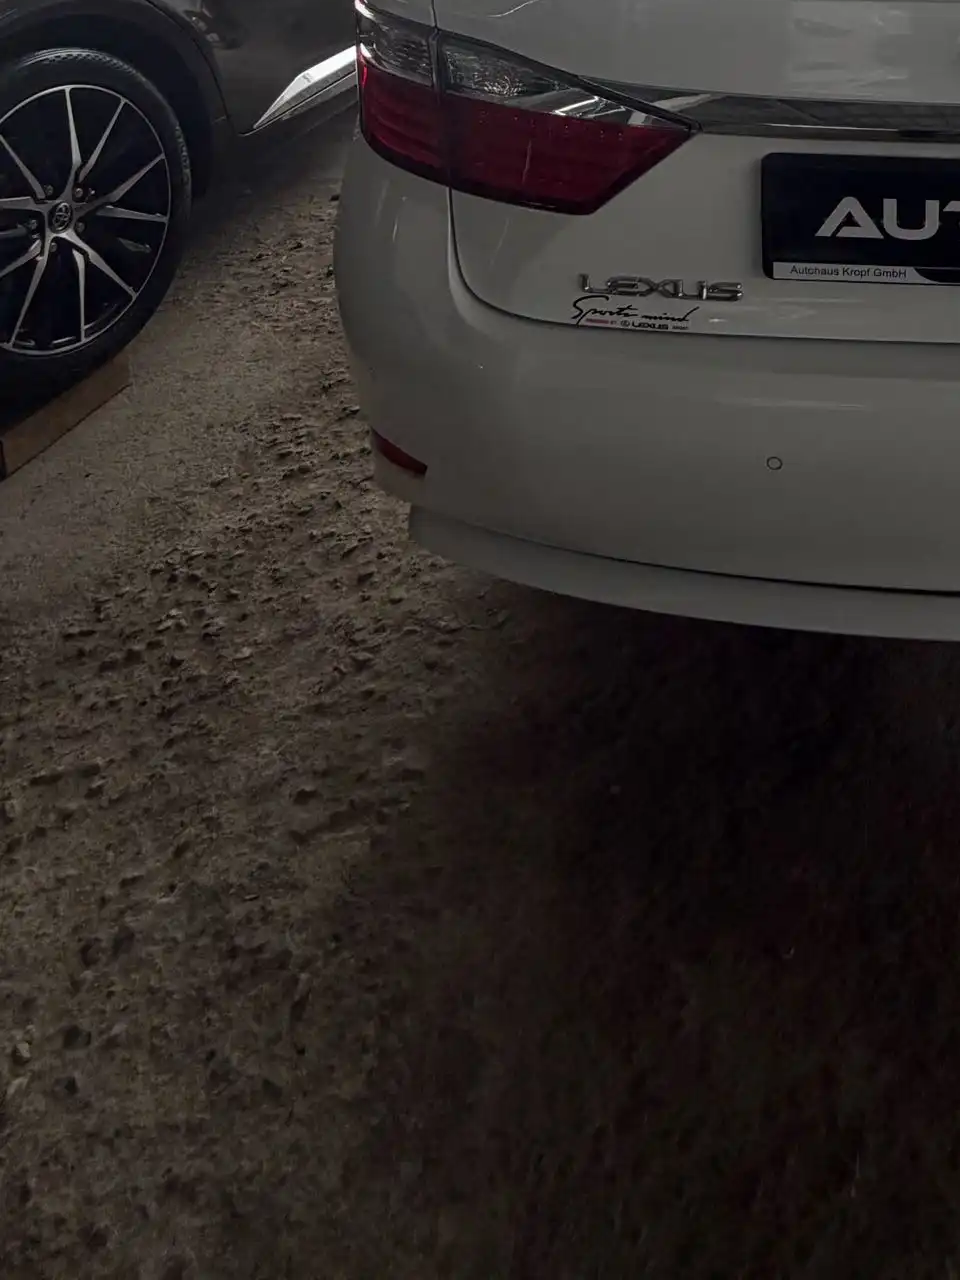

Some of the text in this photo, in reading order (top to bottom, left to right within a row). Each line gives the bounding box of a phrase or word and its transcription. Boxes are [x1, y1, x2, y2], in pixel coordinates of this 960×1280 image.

[790, 265, 907, 279] Autohaus Kropf GmbH
[578, 273, 743, 301] LEXUS
[641, 306, 699, 322] mind
